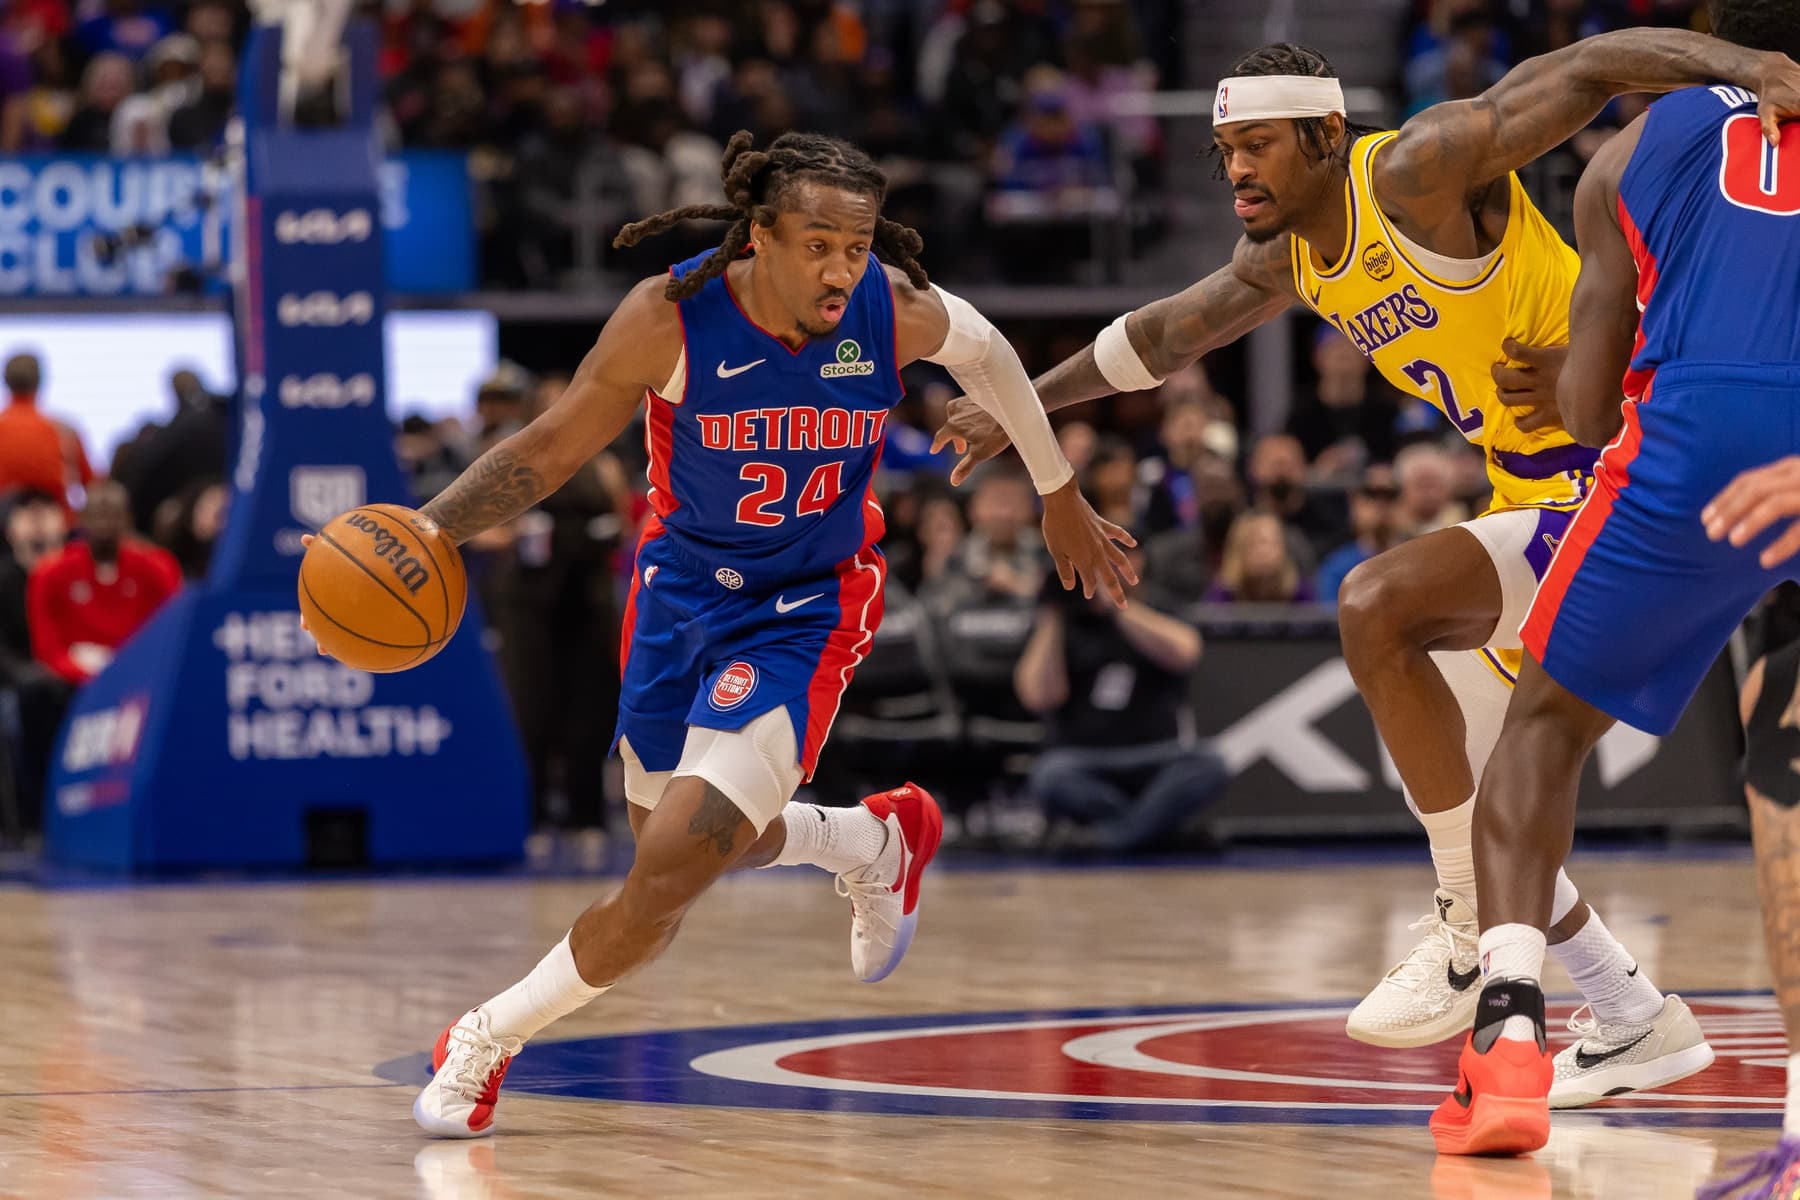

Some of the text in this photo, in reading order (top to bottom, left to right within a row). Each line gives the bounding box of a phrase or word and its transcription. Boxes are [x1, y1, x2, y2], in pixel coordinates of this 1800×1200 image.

[1364, 250, 1390, 272] bibigo
[822, 362, 873, 376] StockX
[1400, 357, 1484, 440] 2
[696, 406, 889, 451] DETROIT
[735, 460, 846, 527] 24
[346, 513, 430, 597] Wilson
[226, 660, 374, 710] FORD
[717, 681, 744, 696] PISTONS
[723, 673, 749, 687] DETROIT
[227, 704, 453, 761] HEALTH
